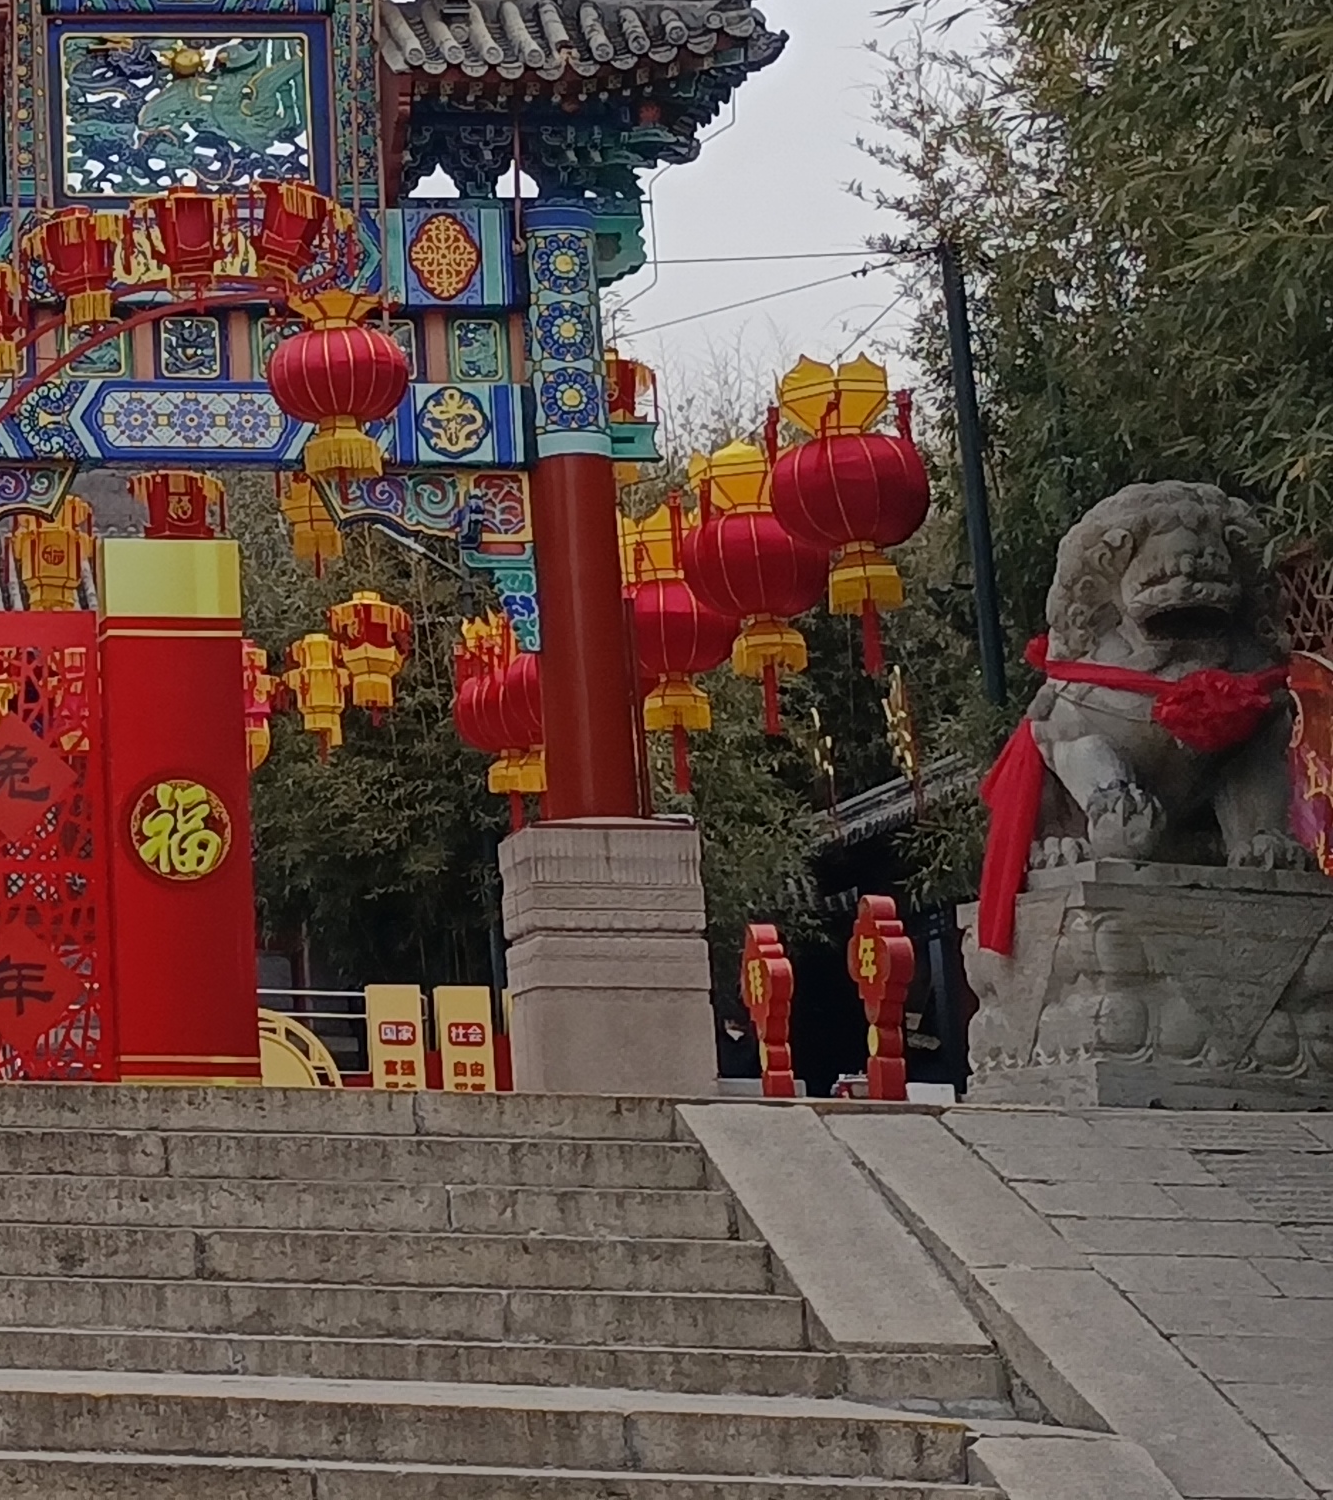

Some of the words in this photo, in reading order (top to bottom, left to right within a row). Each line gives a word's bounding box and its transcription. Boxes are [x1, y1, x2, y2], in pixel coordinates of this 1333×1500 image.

[139, 785, 225, 876] 福
[381, 1023, 414, 1041] 国家
[450, 1025, 483, 1042] 社会
[453, 1060, 485, 1078] 自由
